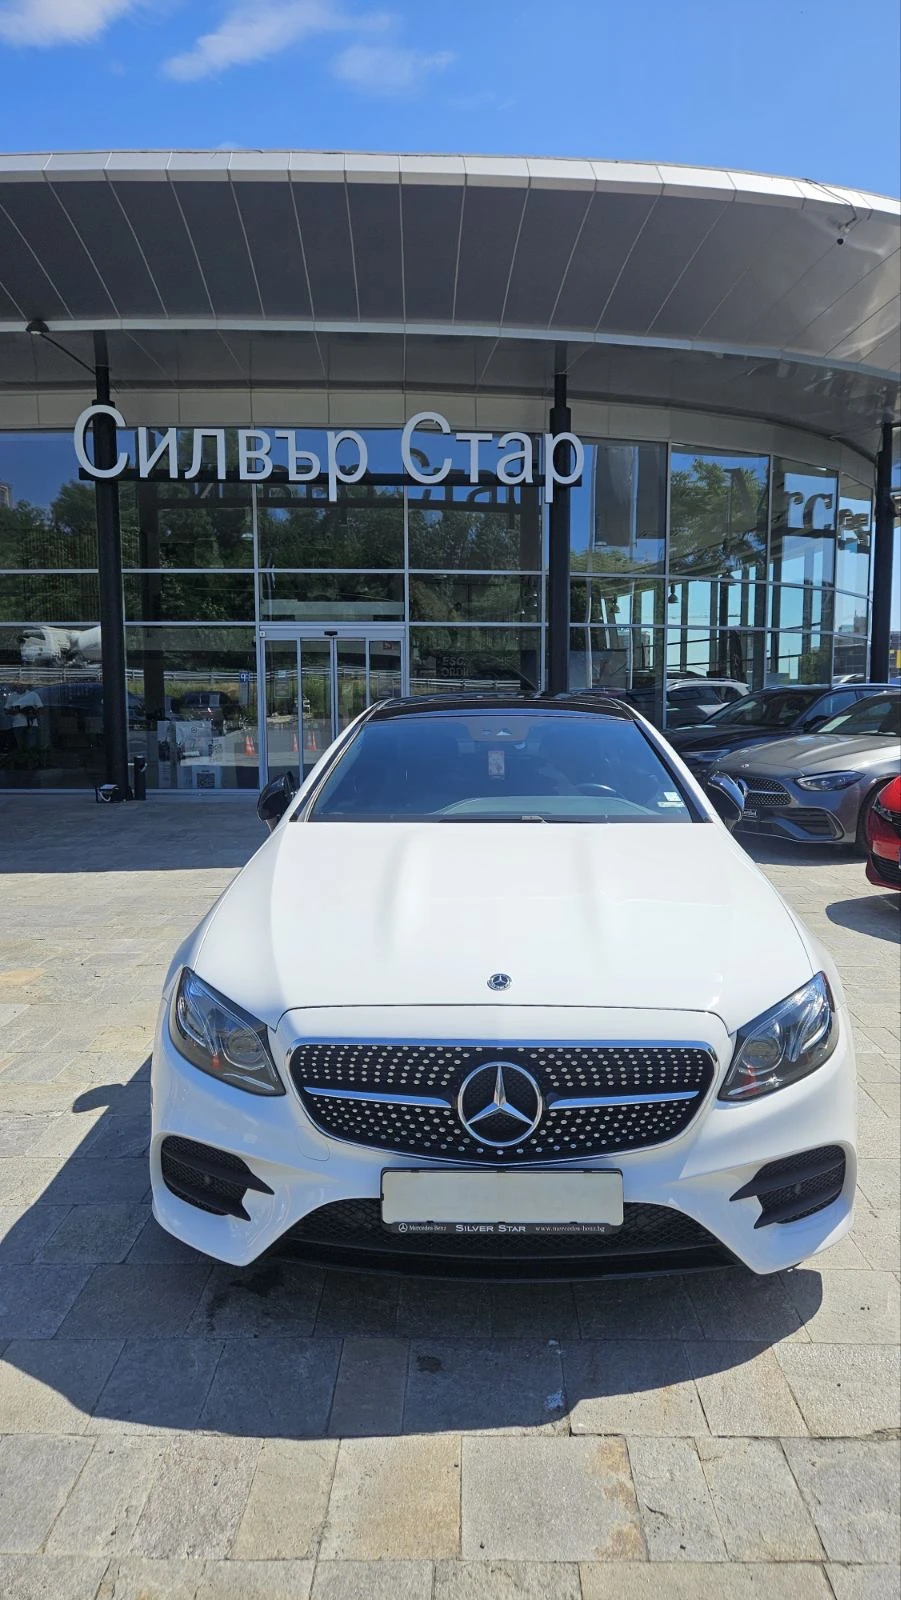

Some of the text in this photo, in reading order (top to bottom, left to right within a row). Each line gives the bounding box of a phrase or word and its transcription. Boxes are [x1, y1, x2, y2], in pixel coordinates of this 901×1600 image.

[73, 404, 368, 502] Силвър
[401, 411, 584, 504] Стар
[455, 1224, 494, 1232] SILVER
[498, 1224, 526, 1232] STAR
